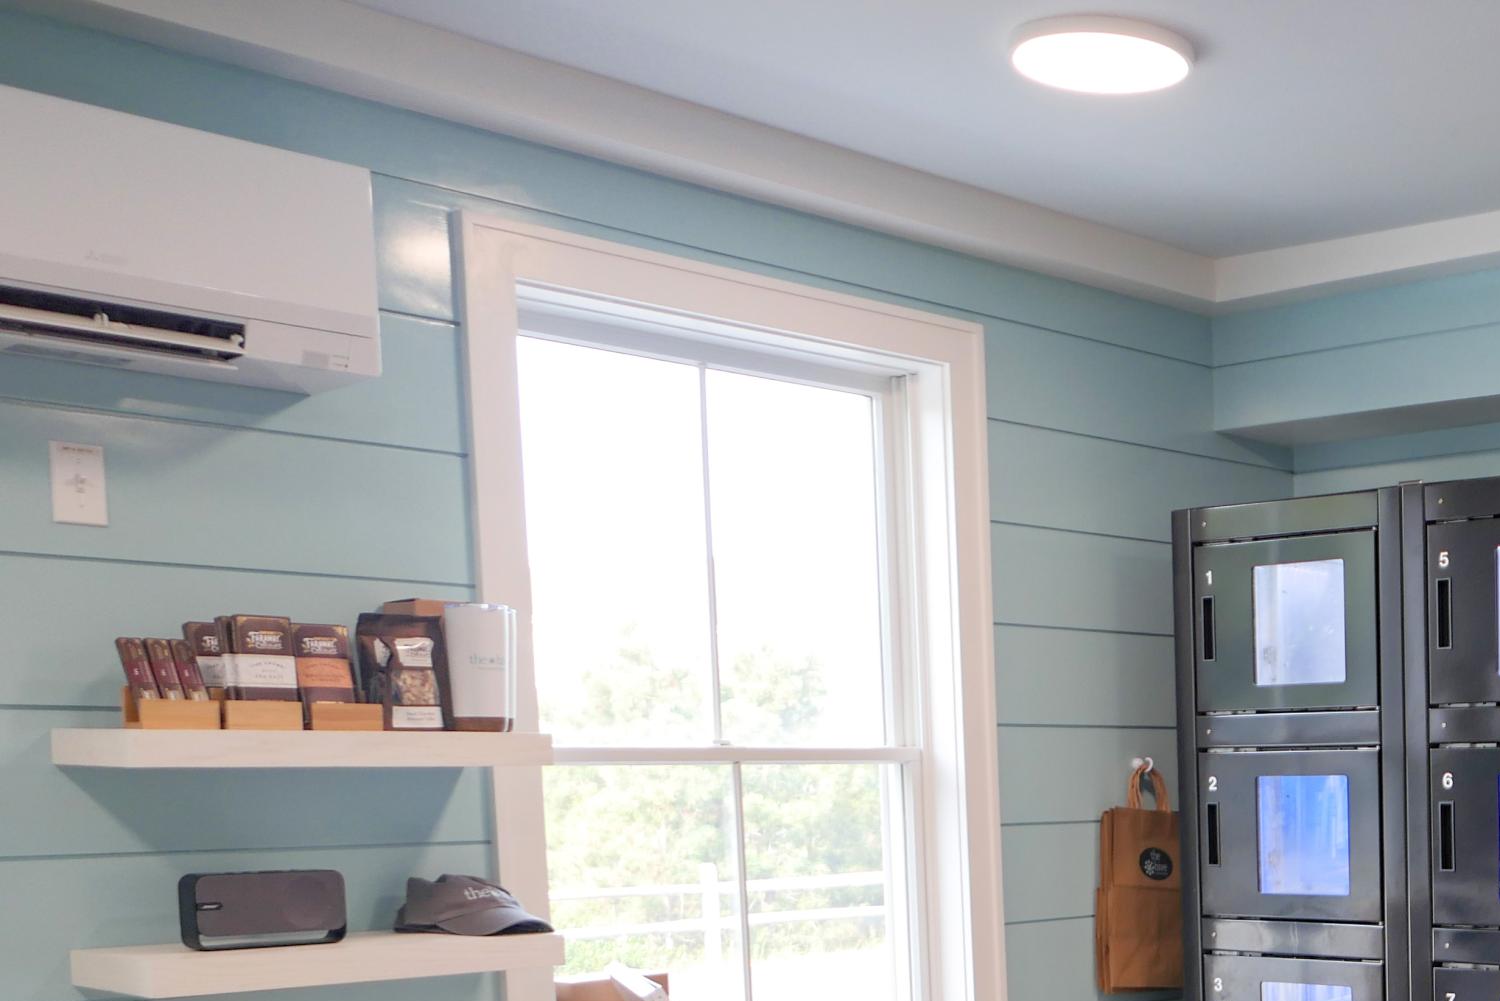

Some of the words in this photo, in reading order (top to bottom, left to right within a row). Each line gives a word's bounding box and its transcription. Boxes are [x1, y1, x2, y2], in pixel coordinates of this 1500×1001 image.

[1438, 551, 1449, 568] 5
[1205, 570, 1213, 584] 1
[1208, 776, 1218, 791] 2
[1442, 772, 1453, 789] 6
[463, 887, 490, 900] the
[1213, 977, 1223, 992] 3
